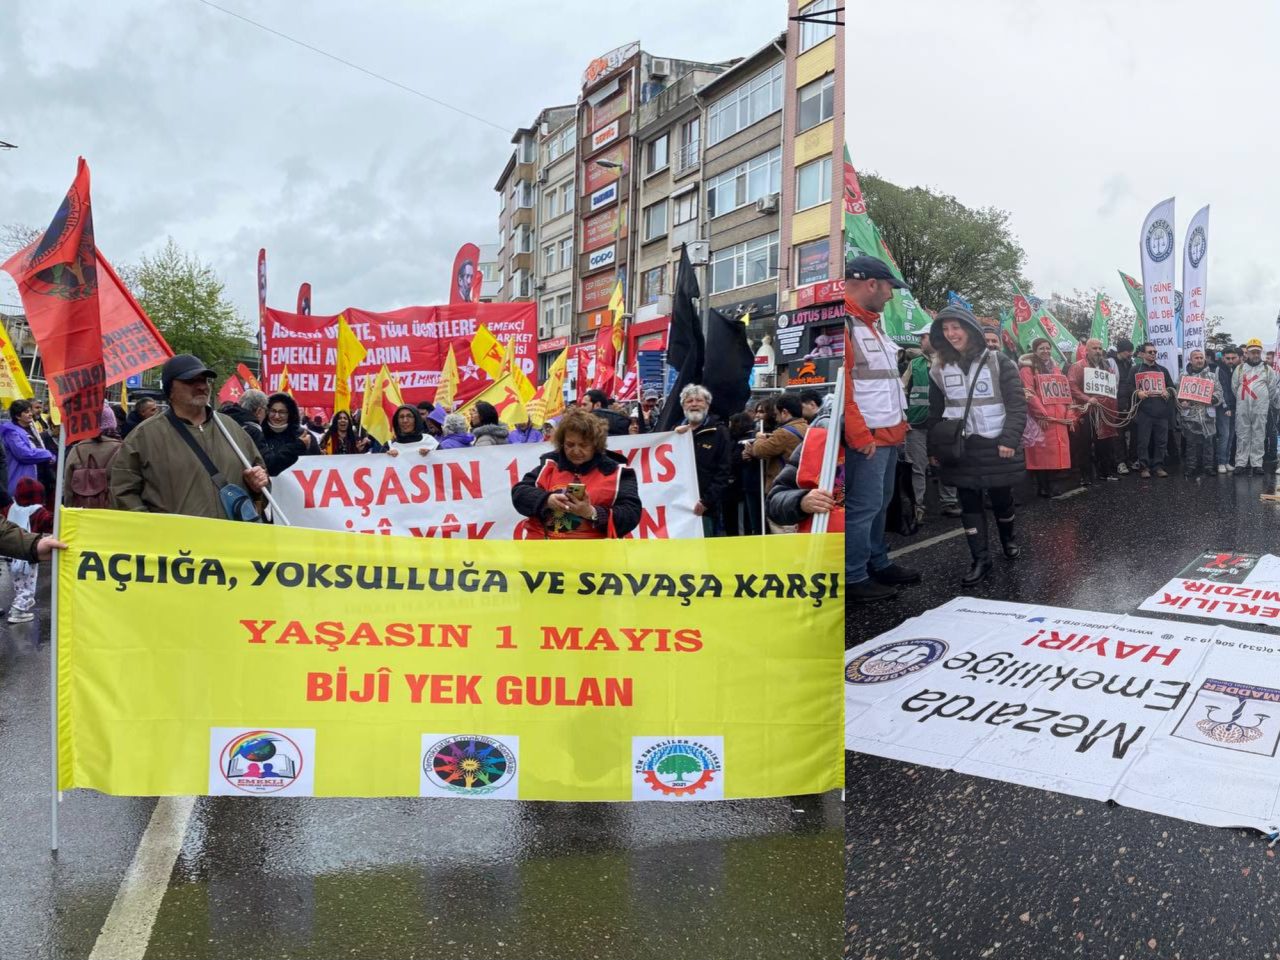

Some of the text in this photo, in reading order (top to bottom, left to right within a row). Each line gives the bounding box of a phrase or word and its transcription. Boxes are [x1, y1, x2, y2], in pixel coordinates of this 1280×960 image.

[590, 249, 613, 267] oppo
[488, 320, 525, 332] EMEKÇİ
[792, 309, 820, 326] LOTUS
[271, 344, 321, 365] EMEKLİ
[1042, 379, 1070, 397] KÖLE
[1183, 381, 1211, 398] KÖLE
[293, 461, 483, 517] YAŞASIN
[77, 550, 839, 607] AÇLIĞA, YOKSULLUĞA VE SAVAŞA KARŞI
[239, 619, 703, 652] YAŞASIN 1 MAYIS
[1021, 629, 1181, 666] HAYIR!
[306, 666, 633, 707] BİJÎ YEK GULAN
[942, 651, 1190, 711] Emekliliğe
[901, 688, 1146, 760] Mezarda
